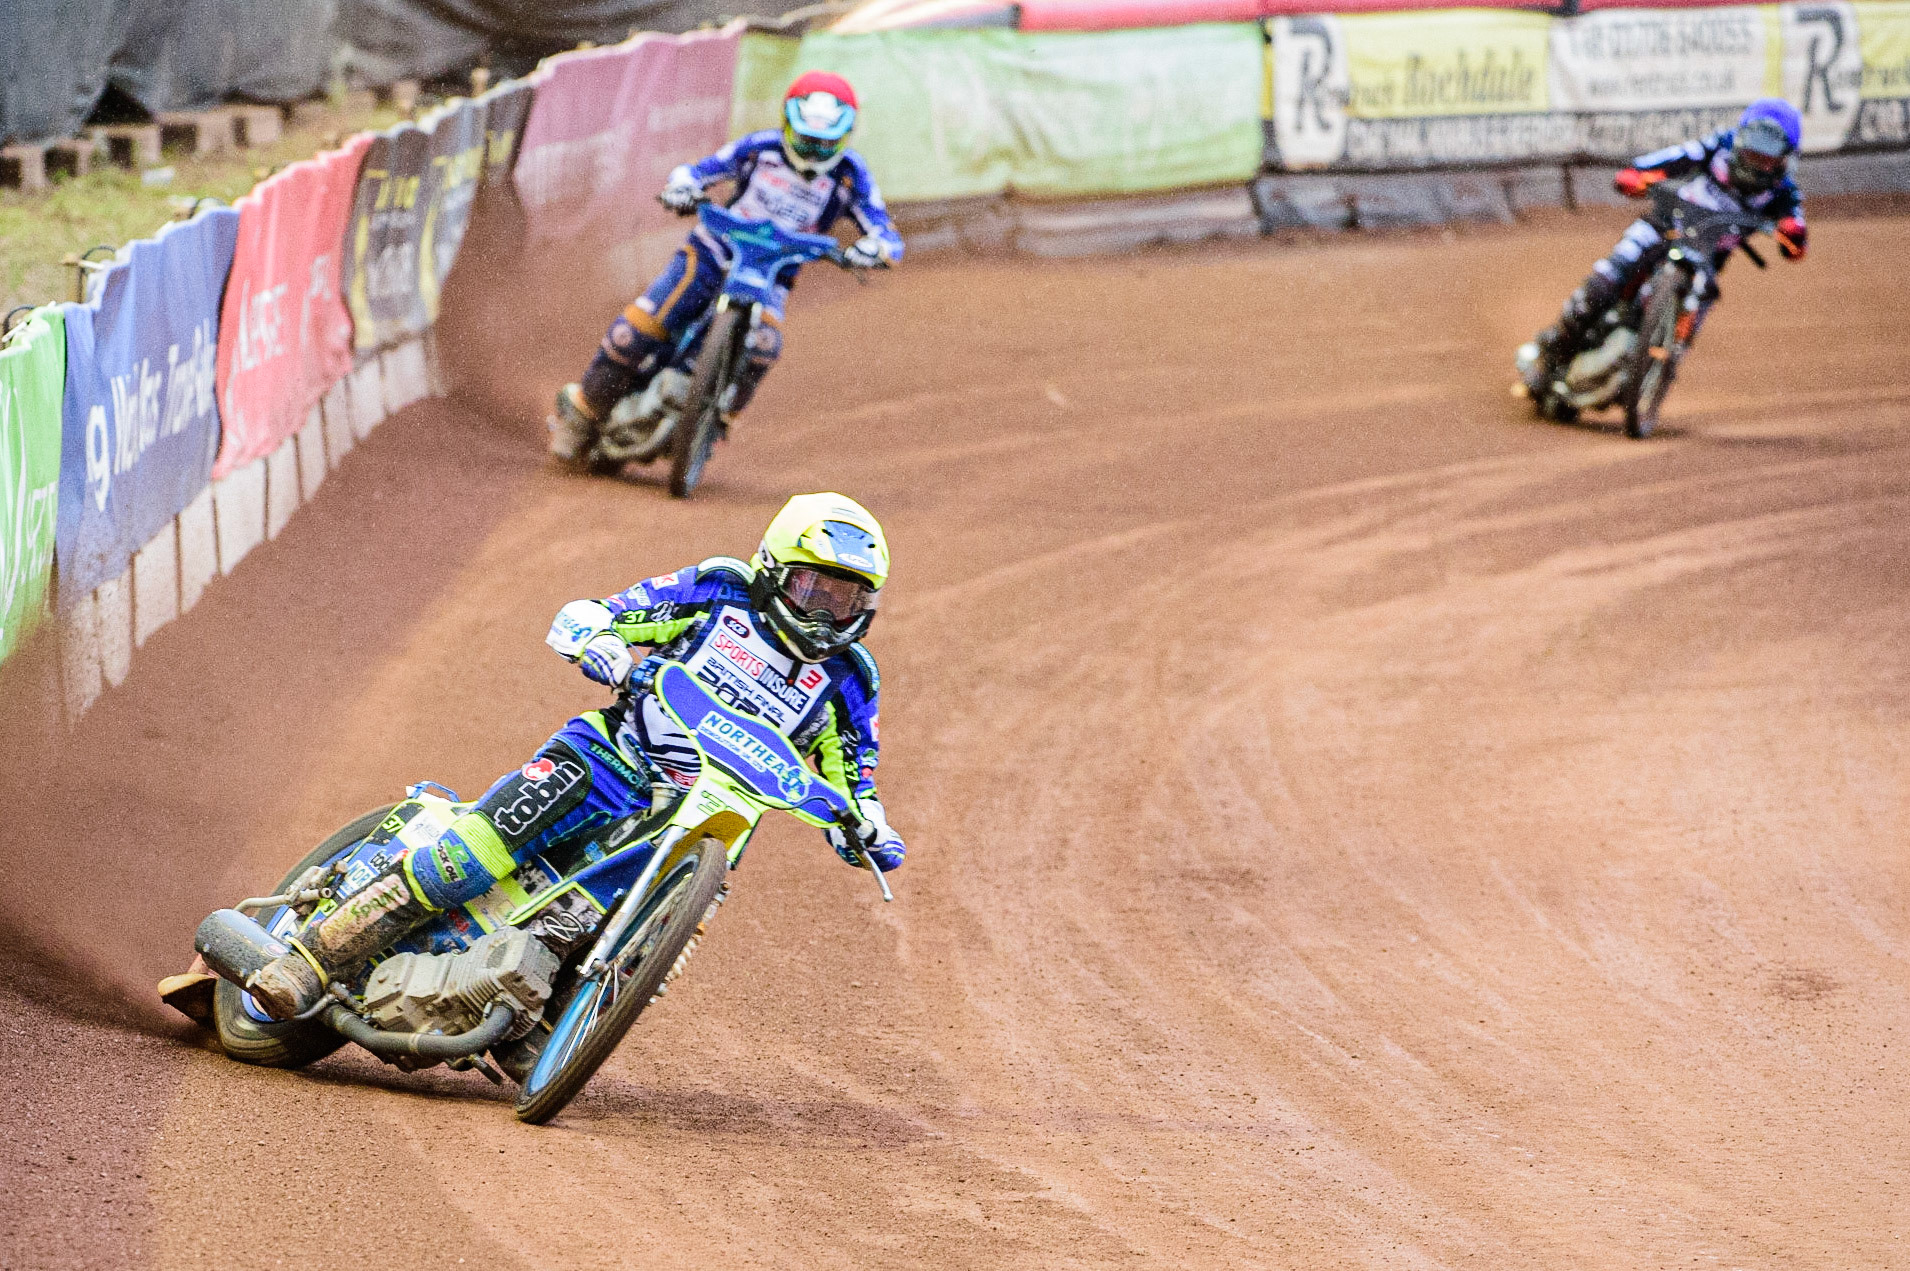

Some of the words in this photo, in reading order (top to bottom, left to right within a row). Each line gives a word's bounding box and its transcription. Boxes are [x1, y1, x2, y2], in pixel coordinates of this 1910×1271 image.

[622, 610, 647, 624] 37
[706, 656, 755, 697] BRITISH
[753, 694, 786, 723] FINAL
[714, 634, 765, 677] SPORTS
[758, 666, 809, 711] INSURE
[800, 669, 824, 690] 3
